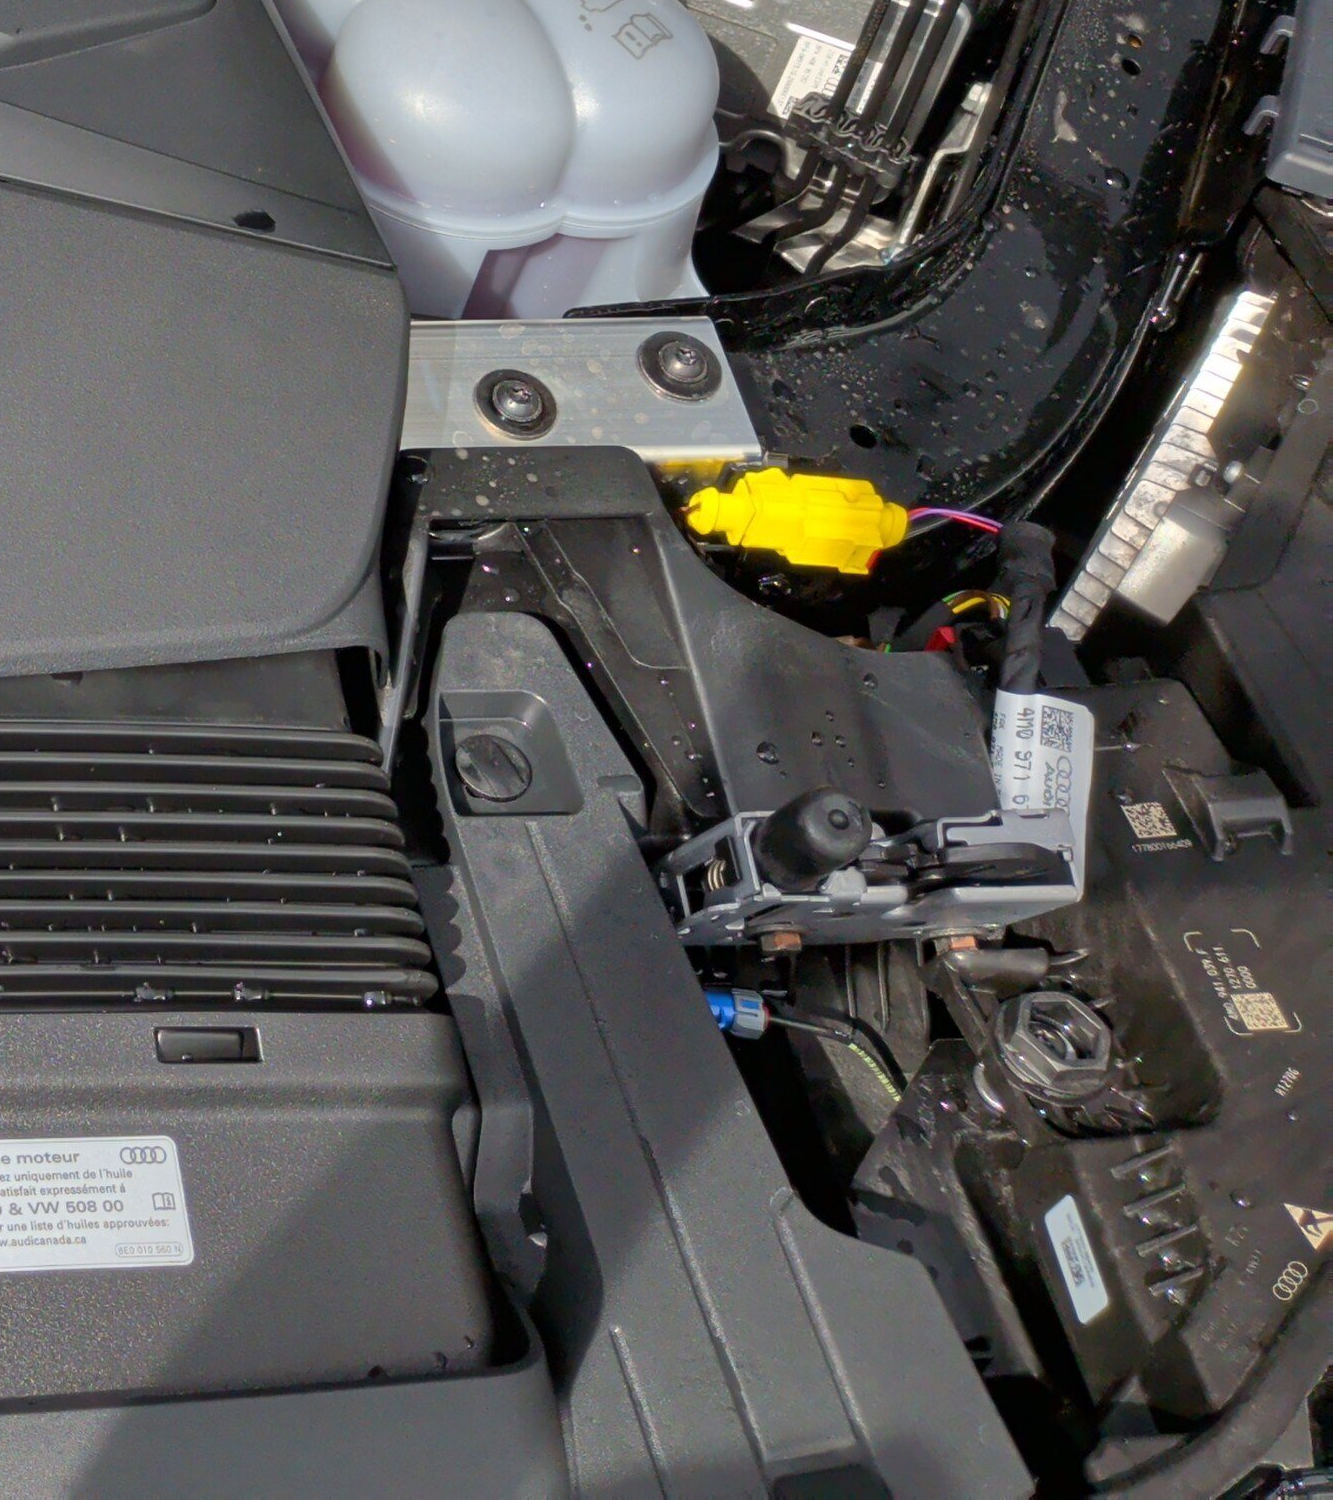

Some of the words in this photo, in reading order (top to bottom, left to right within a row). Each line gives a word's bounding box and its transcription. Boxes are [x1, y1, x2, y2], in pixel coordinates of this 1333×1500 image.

[16, 1152, 80, 1165] moteur
[15, 1170, 79, 1183] uniquement
[83, 1169, 97, 1180] de
[99, 1168, 133, 1179] l'huile
[40, 1184, 116, 1197] expressément
[9, 1202, 23, 1216] &
[27, 1201, 60, 1215] VW
[66, 1200, 97, 1214] 508
[103, 1200, 124, 1213] 00
[7, 1221, 27, 1232] une
[30, 1219, 53, 1231] liste
[56, 1218, 100, 1230] d'huiles
[103, 1218, 170, 1230] approuvées:
